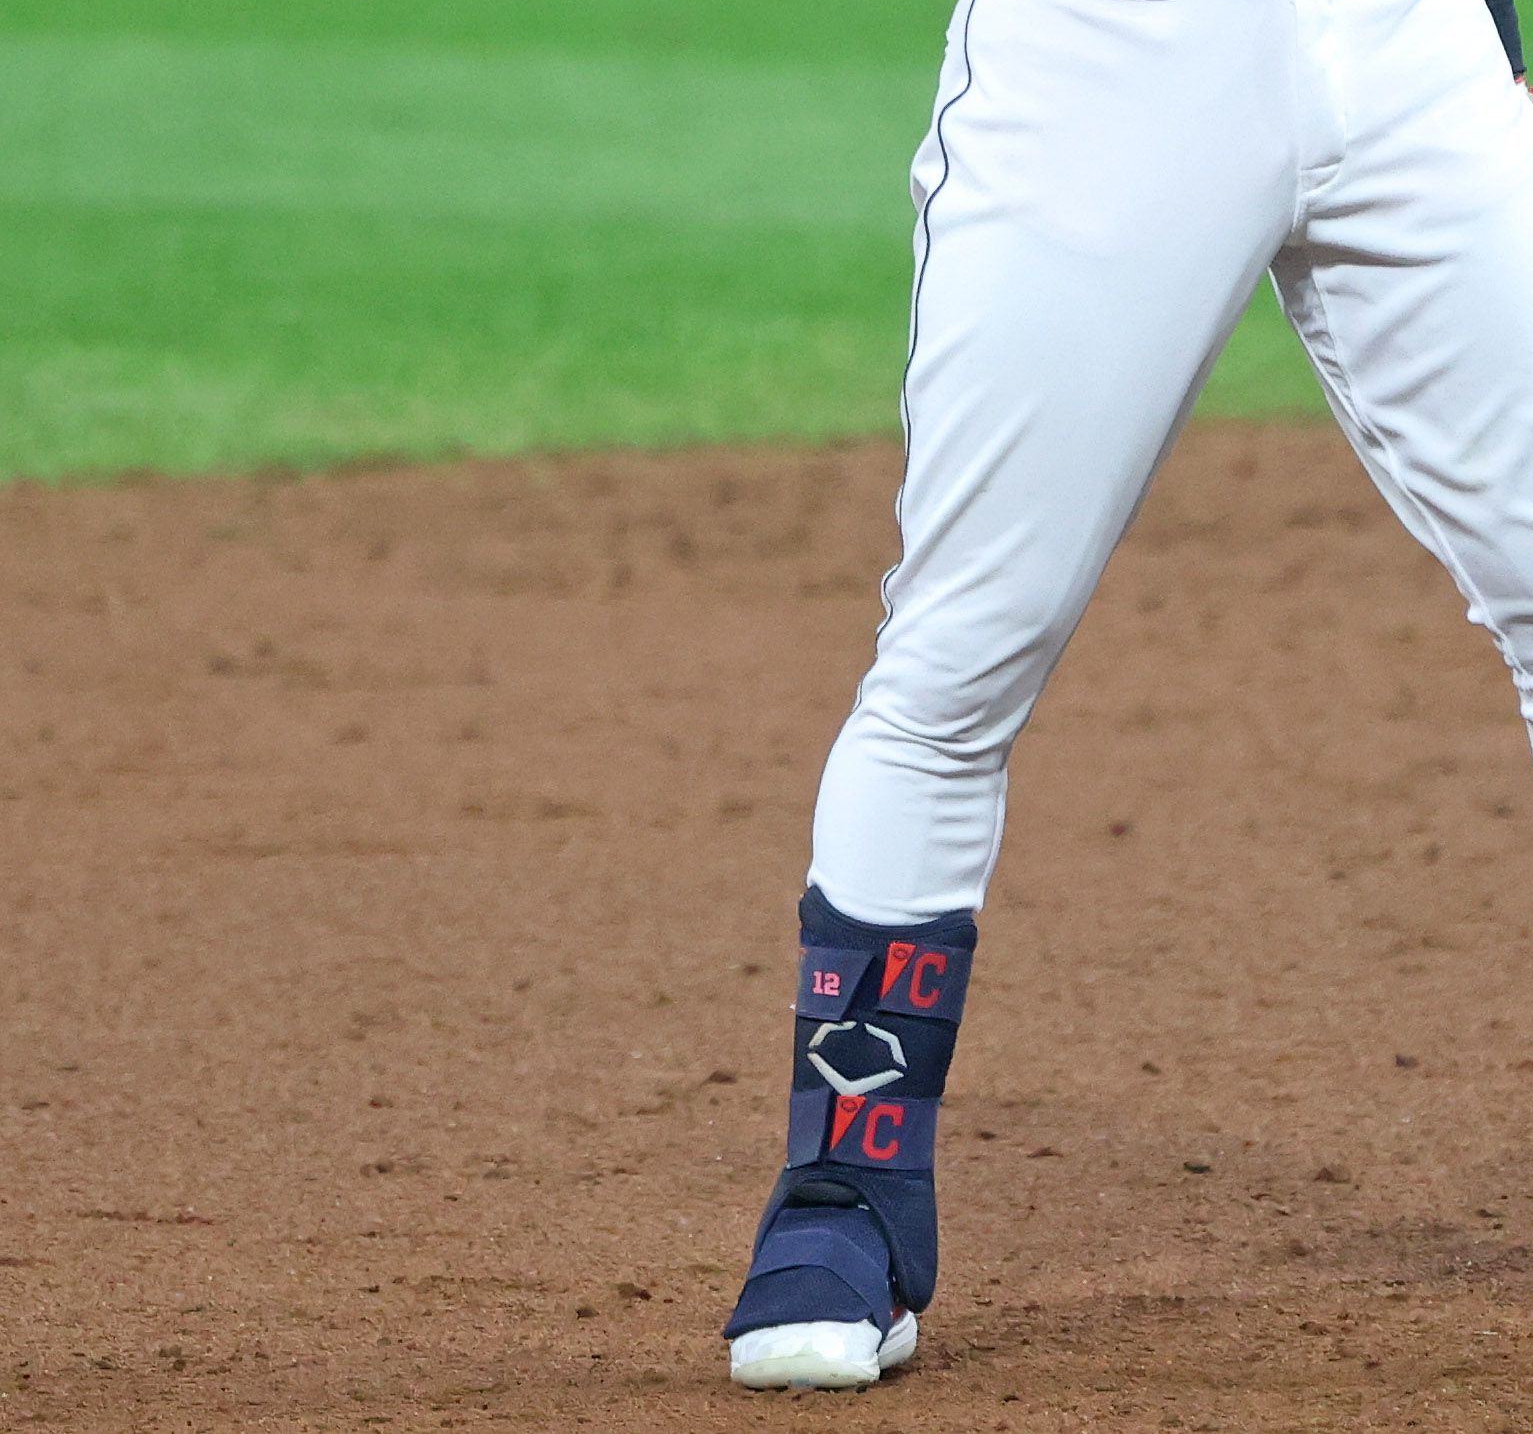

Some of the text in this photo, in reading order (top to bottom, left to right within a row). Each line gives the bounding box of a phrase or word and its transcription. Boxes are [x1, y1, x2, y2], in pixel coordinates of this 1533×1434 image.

[812, 970, 841, 996] 12
[909, 953, 947, 1008] C
[863, 1104, 904, 1160] C
